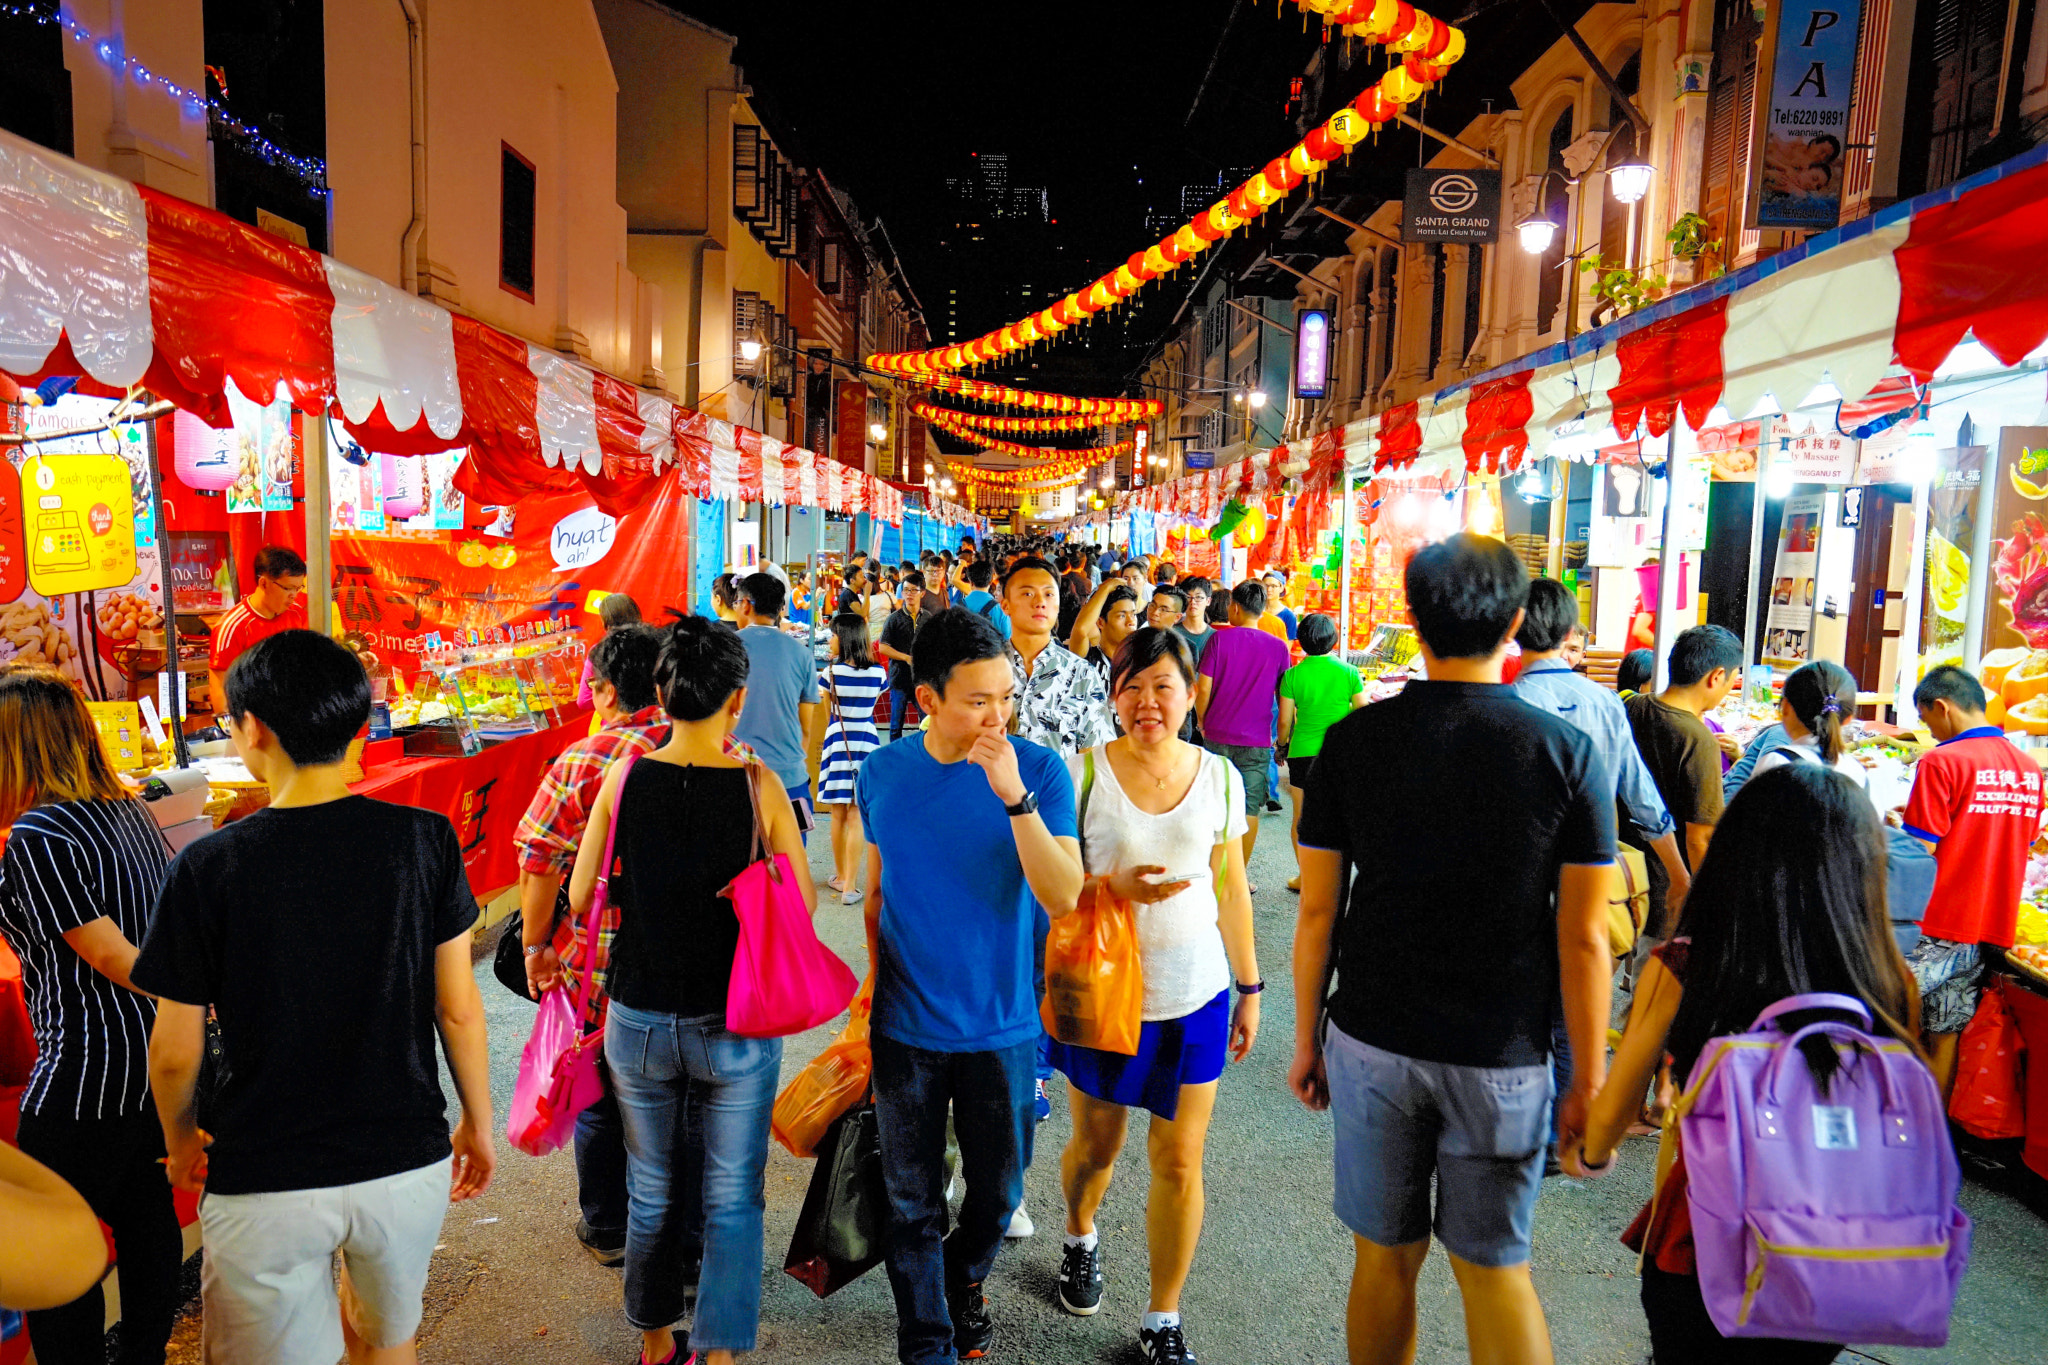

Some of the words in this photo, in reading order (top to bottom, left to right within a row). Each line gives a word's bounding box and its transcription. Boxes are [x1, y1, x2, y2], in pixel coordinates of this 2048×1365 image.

[1819, 111, 1844, 126] 9891
[1787, 128, 1824, 137] wannian
[1415, 216, 1449, 227] SANTA
[1451, 217, 1490, 228] GRAND
[1803, 452, 1841, 463] Massage
[42, 473, 49, 486] 1
[60, 474, 82, 486] cash
[1831, 470, 1842, 478] ST
[91, 509, 112, 523] thank
[95, 522, 110, 533] you
[556, 523, 612, 550] huat
[567, 549, 590, 565] ah!
